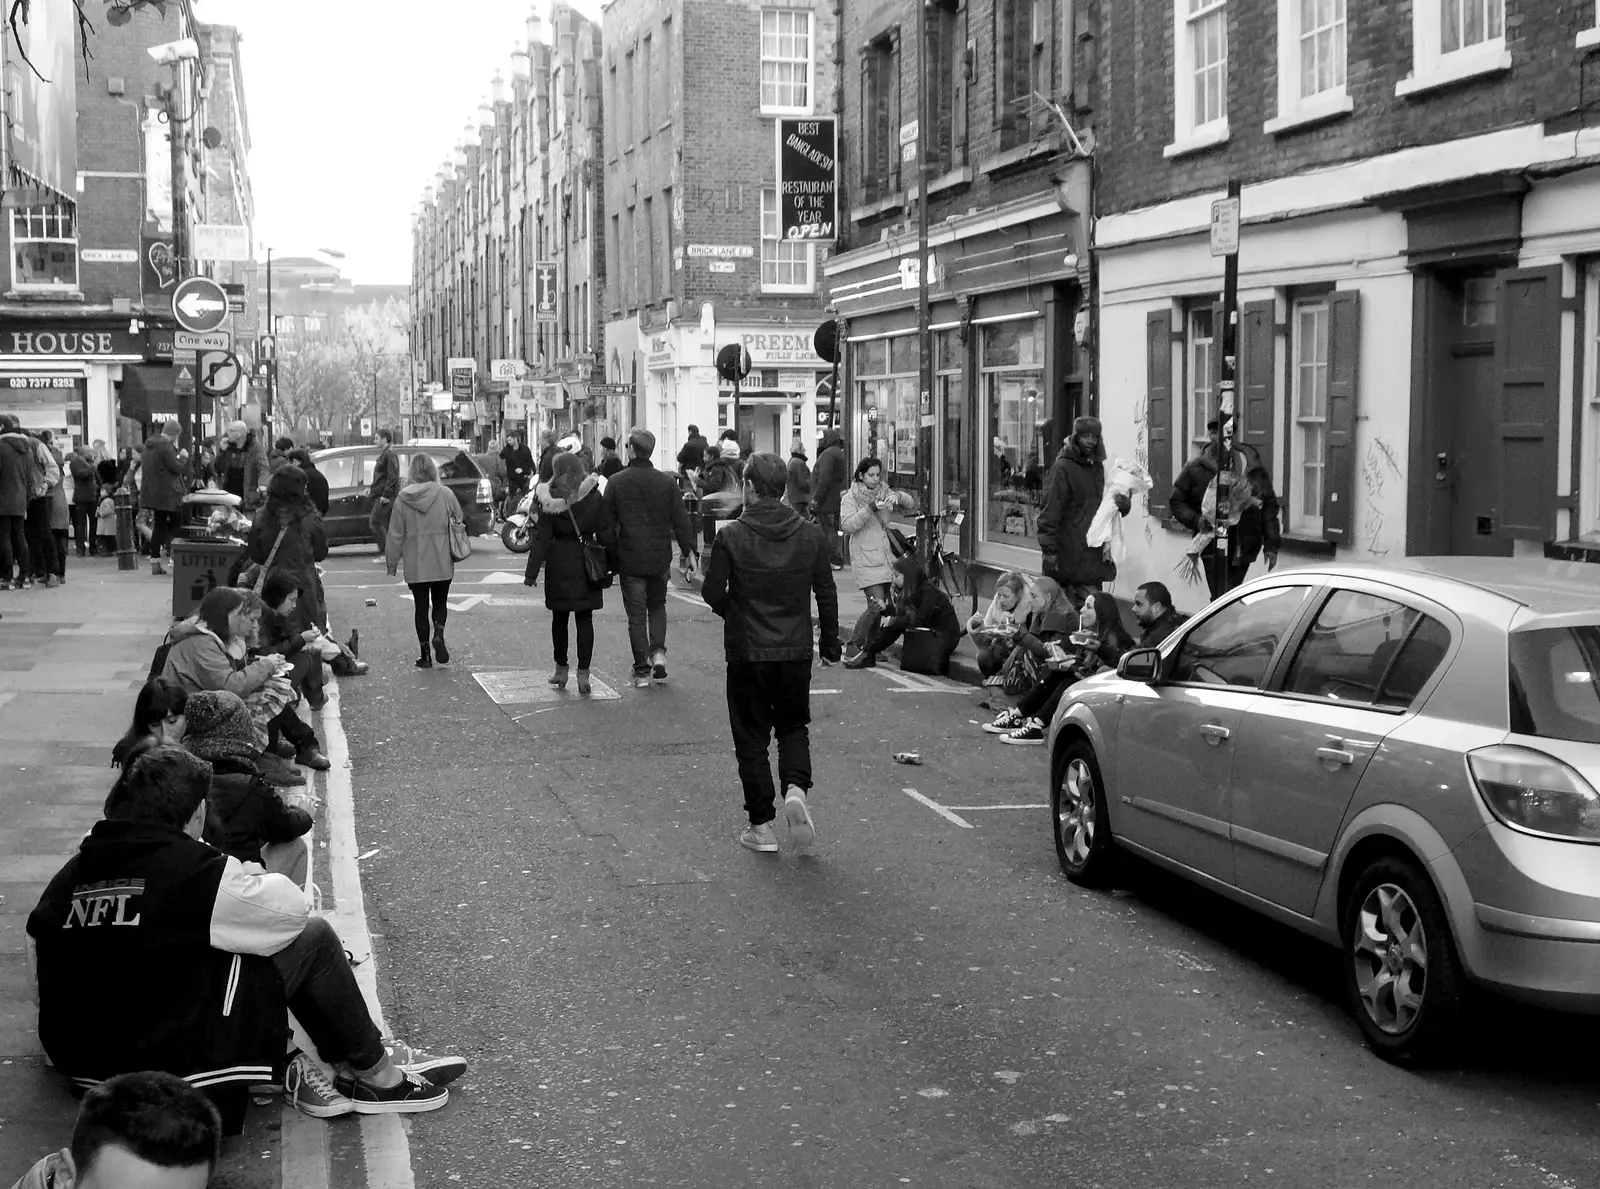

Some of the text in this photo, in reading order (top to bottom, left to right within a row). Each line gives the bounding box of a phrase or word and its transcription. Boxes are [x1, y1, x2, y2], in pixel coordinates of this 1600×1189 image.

[797, 121, 820, 136] BEST
[793, 195, 824, 209] OF THE
[797, 210, 822, 223] YEAR
[788, 222, 832, 240] OPEN
[691, 247, 714, 255] BRICK
[717, 246, 736, 256] LANE
[11, 332, 113, 354] HOUSE
[179, 336, 224, 347] One way
[741, 334, 811, 351] PREEM
[765, 351, 792, 360] FULLY
[10, 378, 27, 388] 020
[28, 378, 51, 388] 7377
[817, 411, 840, 422] OPN
[182, 553, 228, 568] LITTER
[62, 894, 141, 928] NFL
